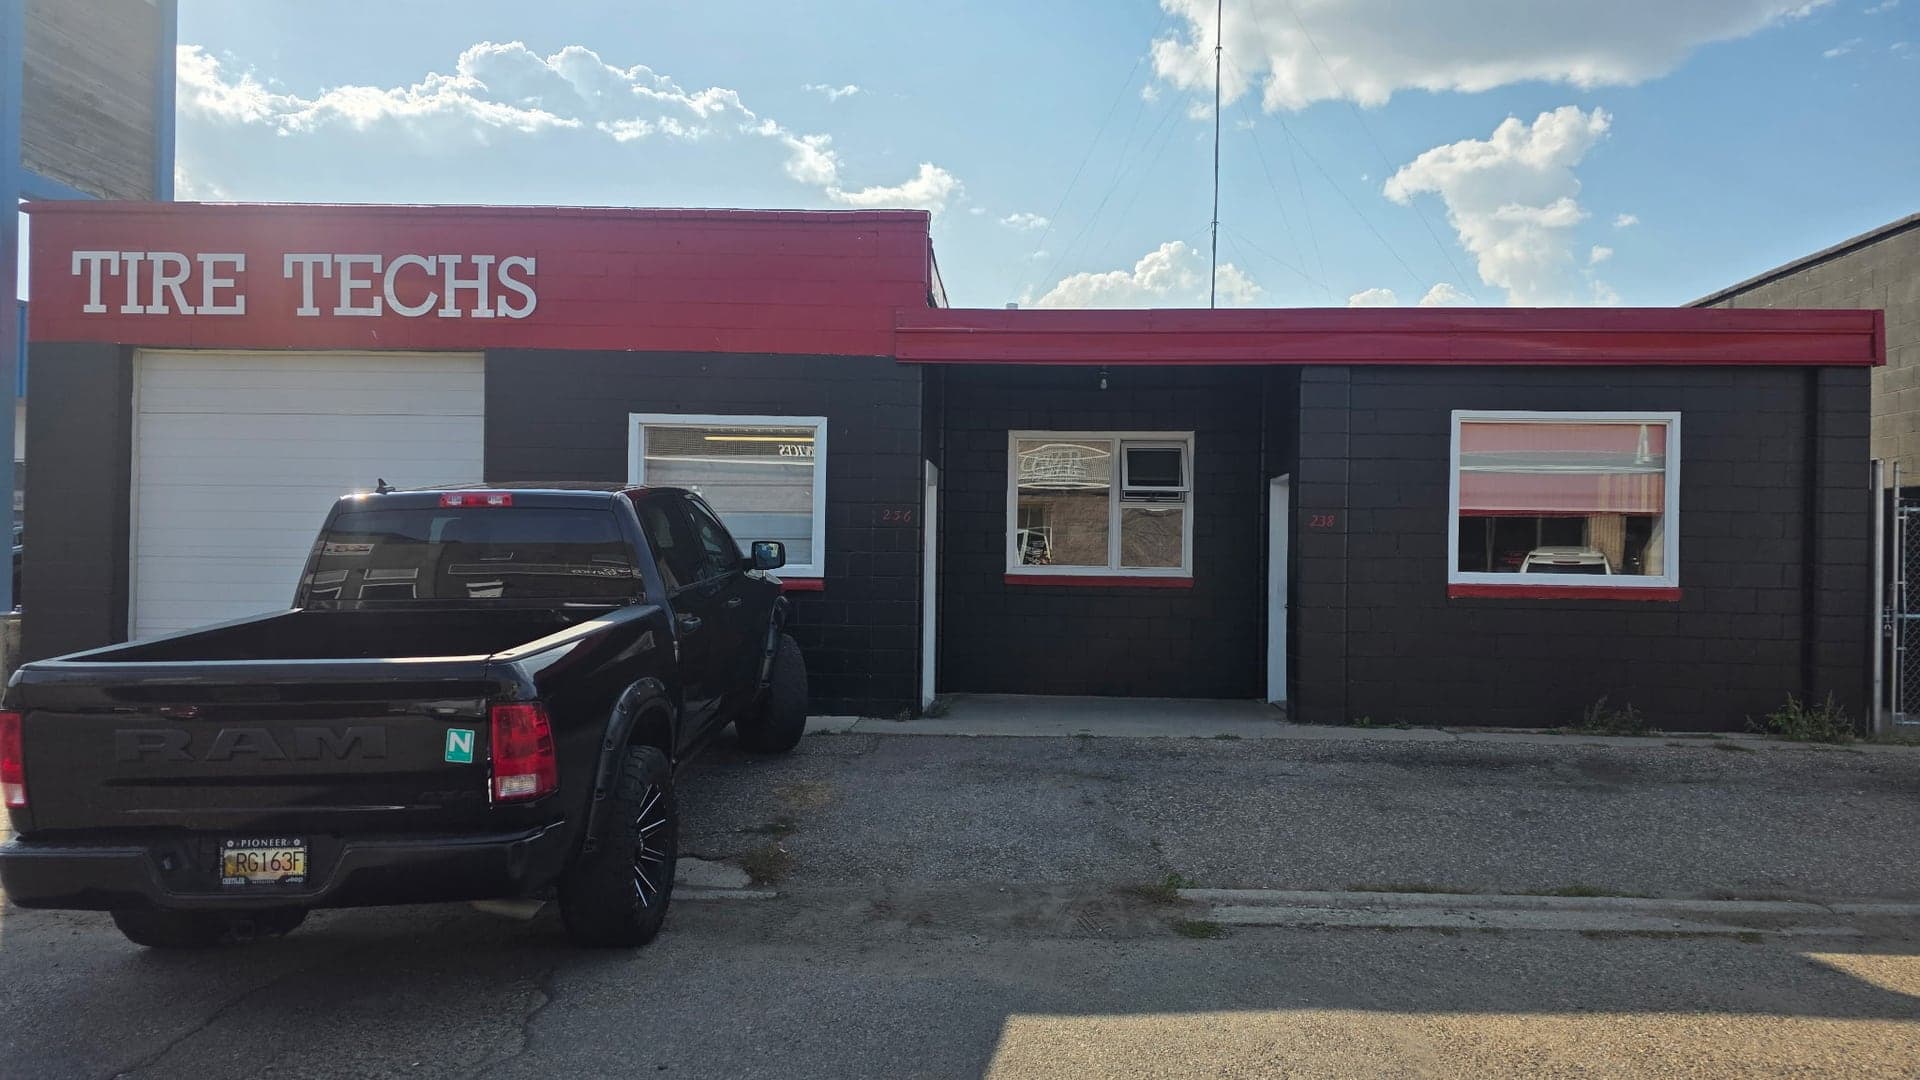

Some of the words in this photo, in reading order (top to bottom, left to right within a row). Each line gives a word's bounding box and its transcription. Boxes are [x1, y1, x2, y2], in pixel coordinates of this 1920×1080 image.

[72, 250, 246, 316] TIRE
[283, 252, 538, 319] TECHS
[1310, 514, 1335, 527] 238
[114, 727, 388, 761] RAM
[449, 732, 471, 753] N
[241, 839, 287, 847] PIONEER
[236, 851, 304, 872] RG163F
